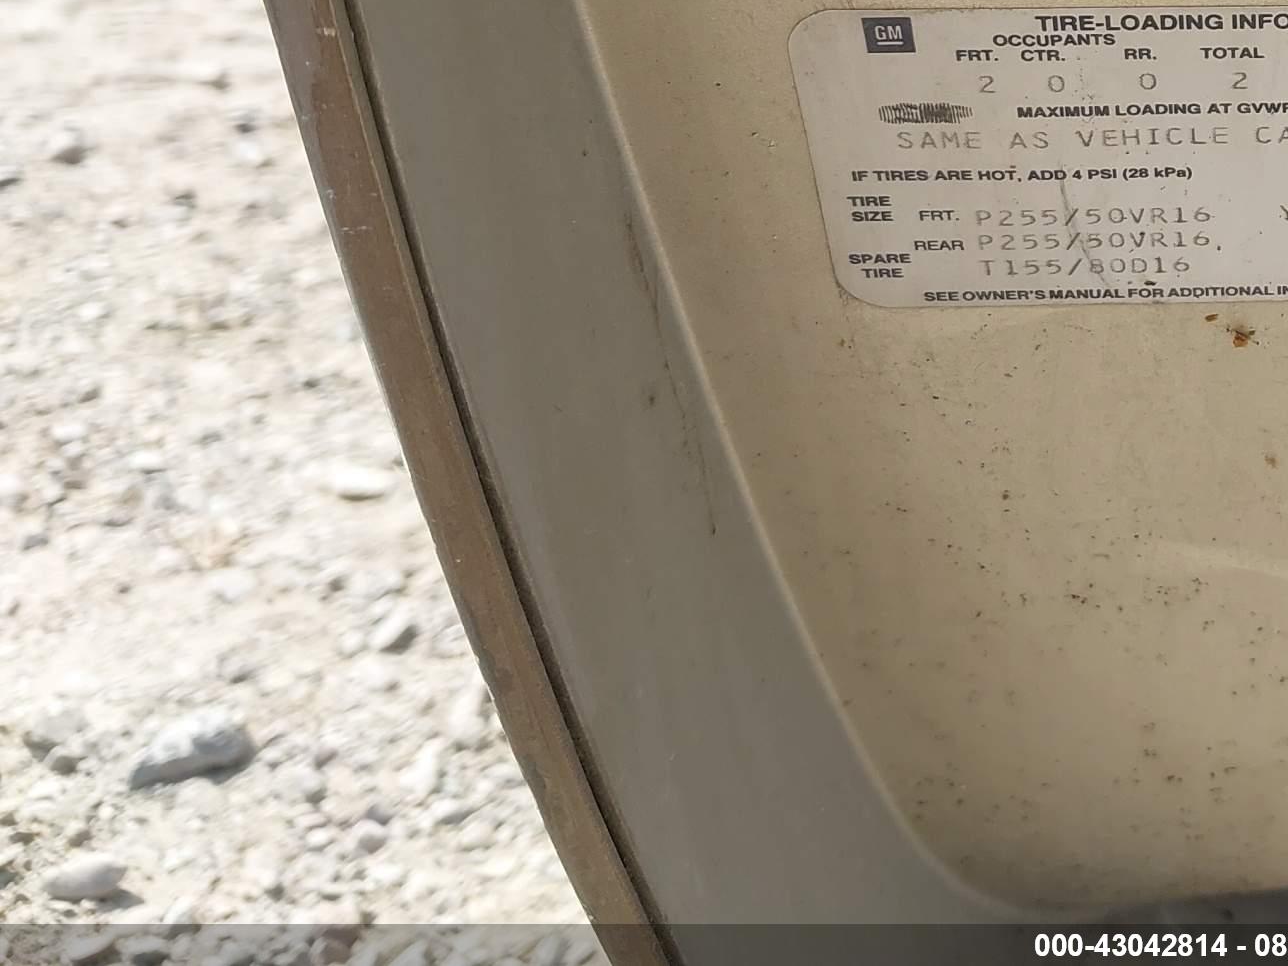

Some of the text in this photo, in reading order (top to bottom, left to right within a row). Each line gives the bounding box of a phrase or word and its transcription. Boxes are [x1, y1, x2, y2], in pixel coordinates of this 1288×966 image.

[1035, 15, 1223, 32] TIRE-LOADING
[874, 24, 903, 41] GM
[993, 33, 1116, 48] OCCUPANTS
[956, 49, 999, 62] FRT.
[1021, 49, 1066, 62] CTR.
[1124, 47, 1157, 61] RR.
[1200, 46, 1265, 60] TOTAL
[979, 75, 996, 94] 2
[1047, 75, 1065, 93] 0
[1139, 72, 1157, 91] 0
[1231, 71, 1249, 90] 2
[1017, 104, 1113, 118] MAXIMUM
[1115, 103, 1202, 117] LOADING
[1208, 103, 1232, 116] AT
[896, 131, 982, 150] SAME
[1009, 130, 1050, 150] AS
[1075, 127, 1229, 148] VEHICLE
[852, 166, 1193, 183] IF TIRES ARE HOT, ADD 4 PSI (28 kPa)
[847, 196, 892, 207] TIRE
[851, 210, 894, 222] SIZE
[919, 210, 960, 222] FRT.
[975, 208, 1212, 227] P255/50VR16
[914, 240, 965, 251] REAR
[849, 253, 912, 265] SPARE
[981, 257, 1190, 277] T155/80D16
[861, 267, 905, 279] TIRE
[924, 291, 961, 302] SEE
[962, 290, 1046, 302] OWNER'S
[1048, 288, 1125, 300] MANUAL
[1128, 288, 1164, 299] FOR
[1168, 285, 1275, 299] ADDITIONAL
